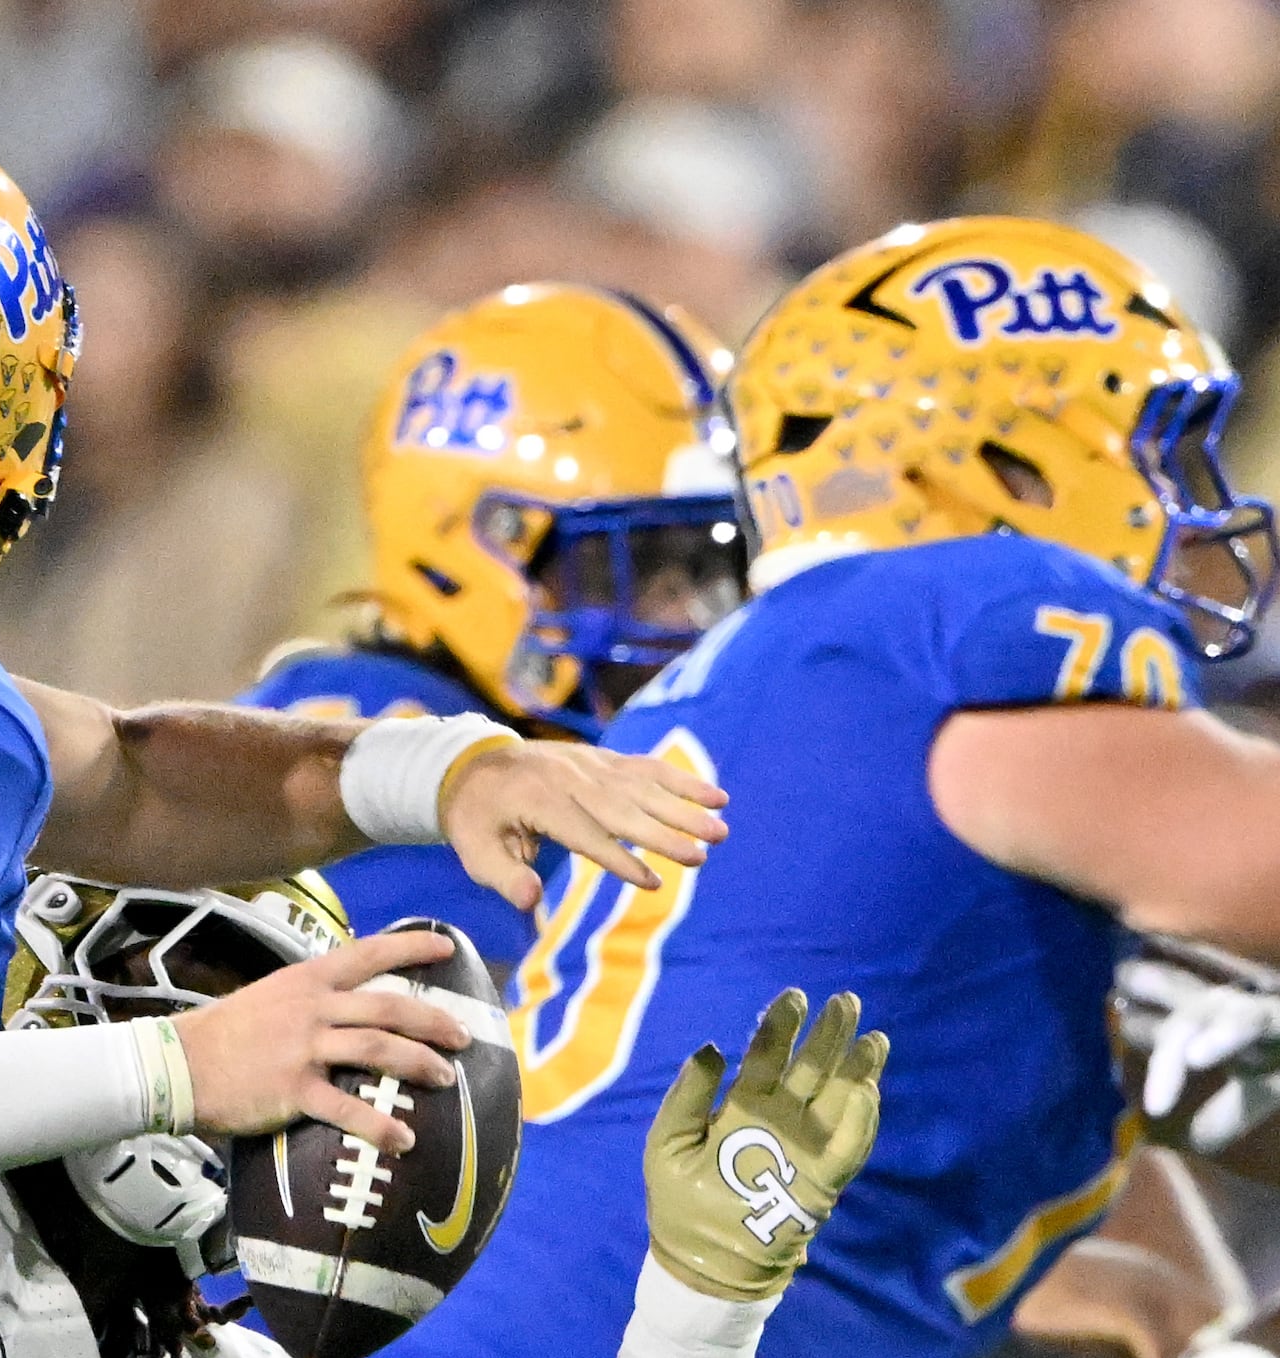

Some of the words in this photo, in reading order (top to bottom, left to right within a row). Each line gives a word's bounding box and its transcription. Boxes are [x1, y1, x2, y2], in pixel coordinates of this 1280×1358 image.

[914, 260, 1117, 341] Pitt
[1035, 605, 1187, 710] 70
[718, 1126, 816, 1247] GT
